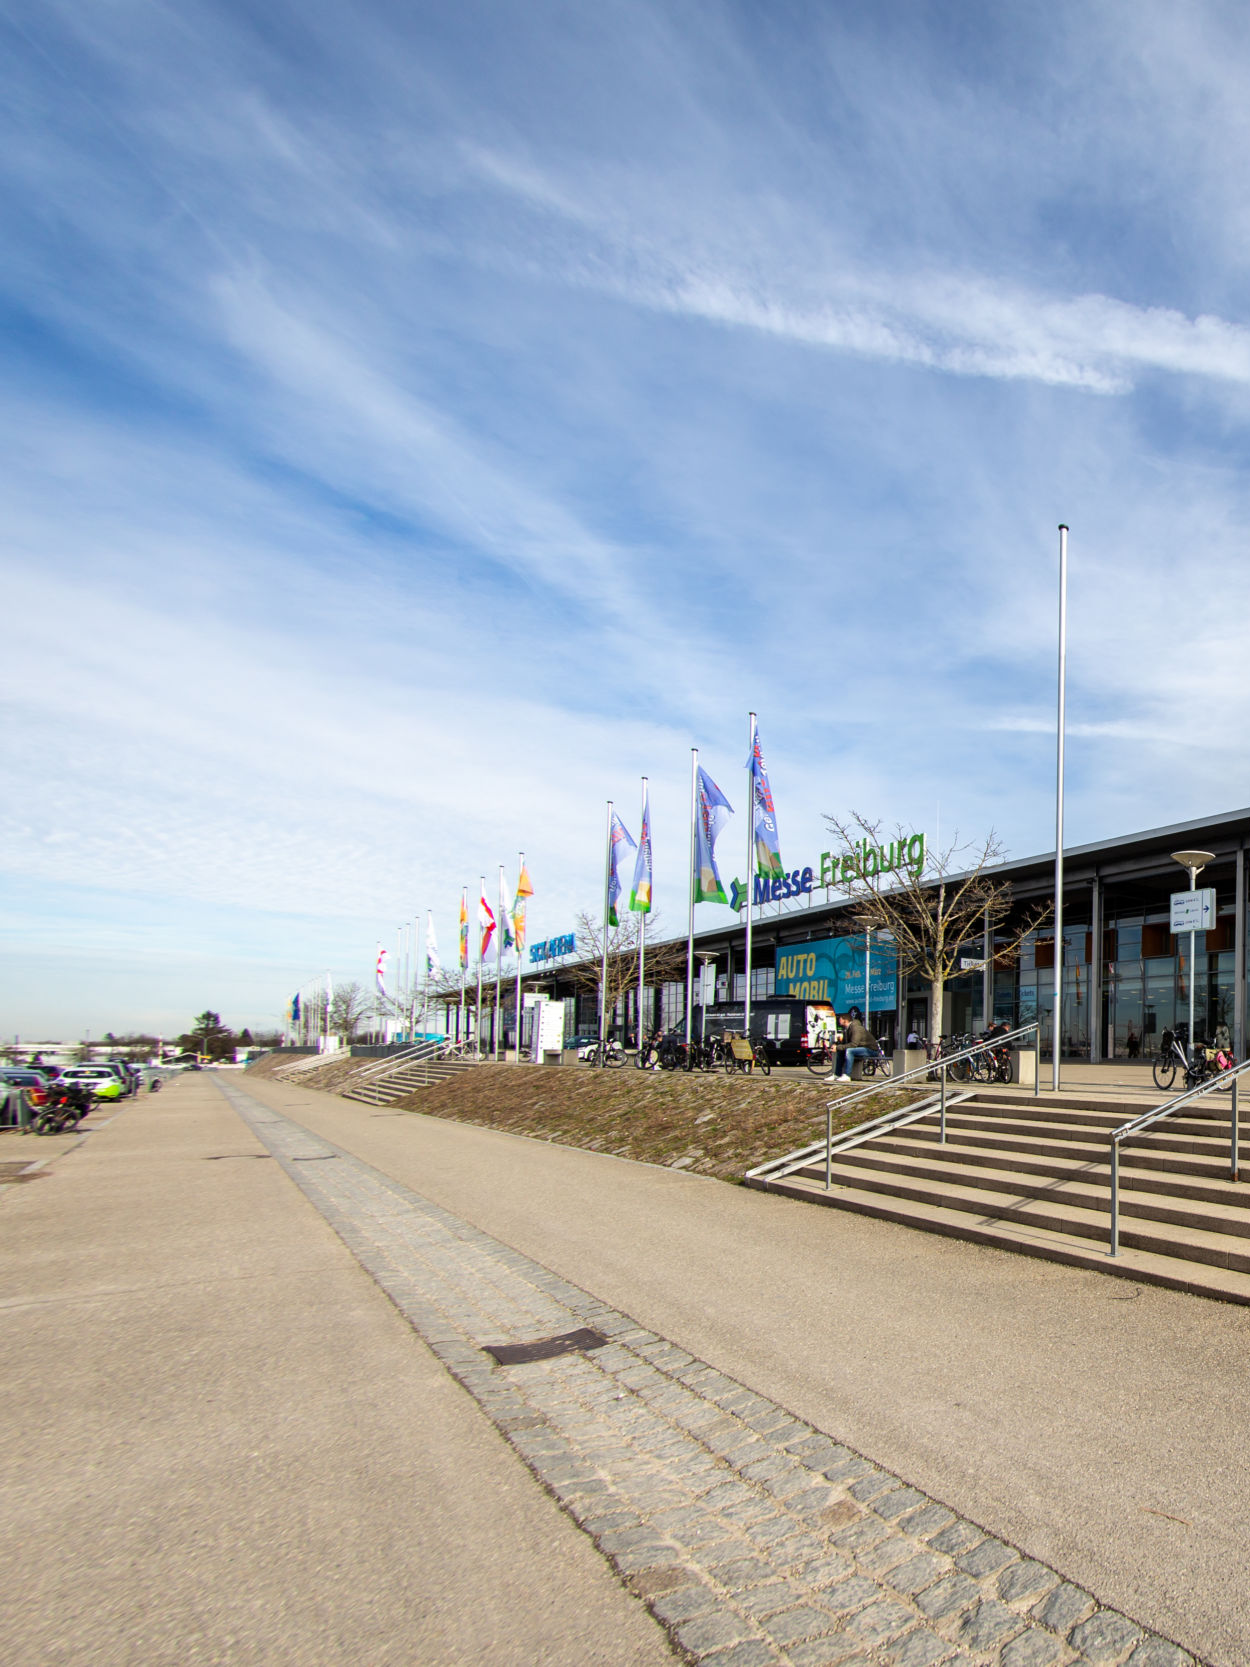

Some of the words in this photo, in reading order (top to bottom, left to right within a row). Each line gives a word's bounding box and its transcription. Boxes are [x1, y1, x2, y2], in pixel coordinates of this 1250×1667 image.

[753, 866, 814, 905] Messe
[820, 832, 927, 889] Freiburg
[778, 952, 816, 979] AUTO
[789, 979, 832, 1001] MOBIL
[845, 983, 865, 994] Messe
[868, 980, 895, 993] reiburg
